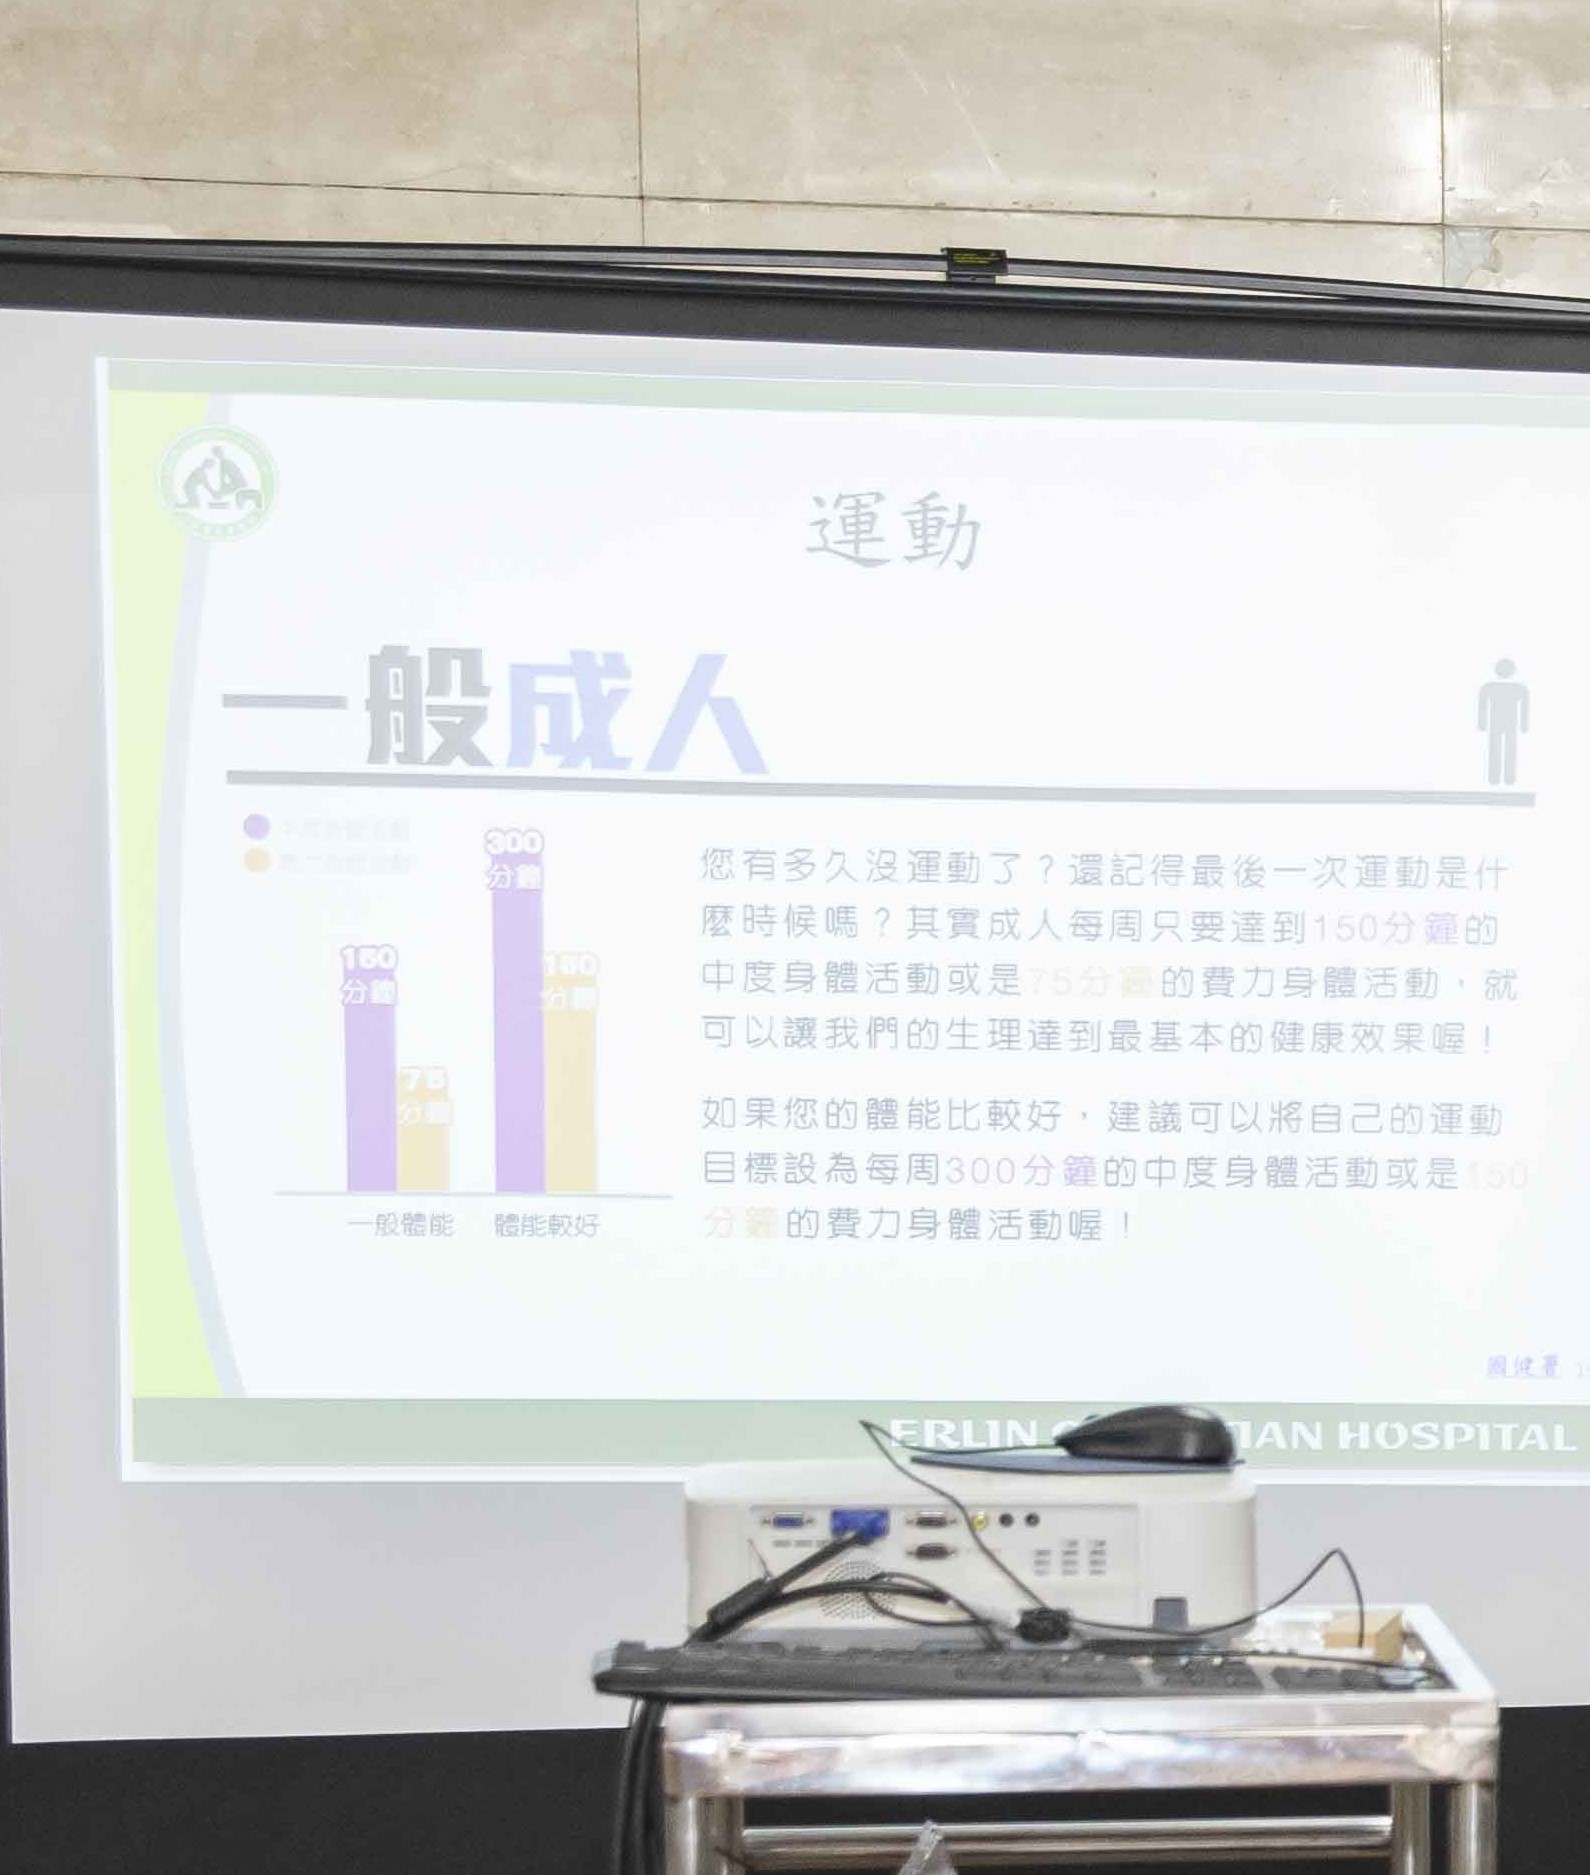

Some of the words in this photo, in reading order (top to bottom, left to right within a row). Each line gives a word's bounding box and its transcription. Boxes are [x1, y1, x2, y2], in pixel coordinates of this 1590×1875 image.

[804, 489, 983, 573] 運動
[222, 643, 771, 775] 一般成人
[483, 827, 545, 855] 300
[348, 1212, 457, 1238] 一般體能
[494, 1212, 602, 1239] 體能較好
[891, 1418, 1038, 1447] ERLIN
[1339, 1420, 1577, 1452] HOSPITAL
